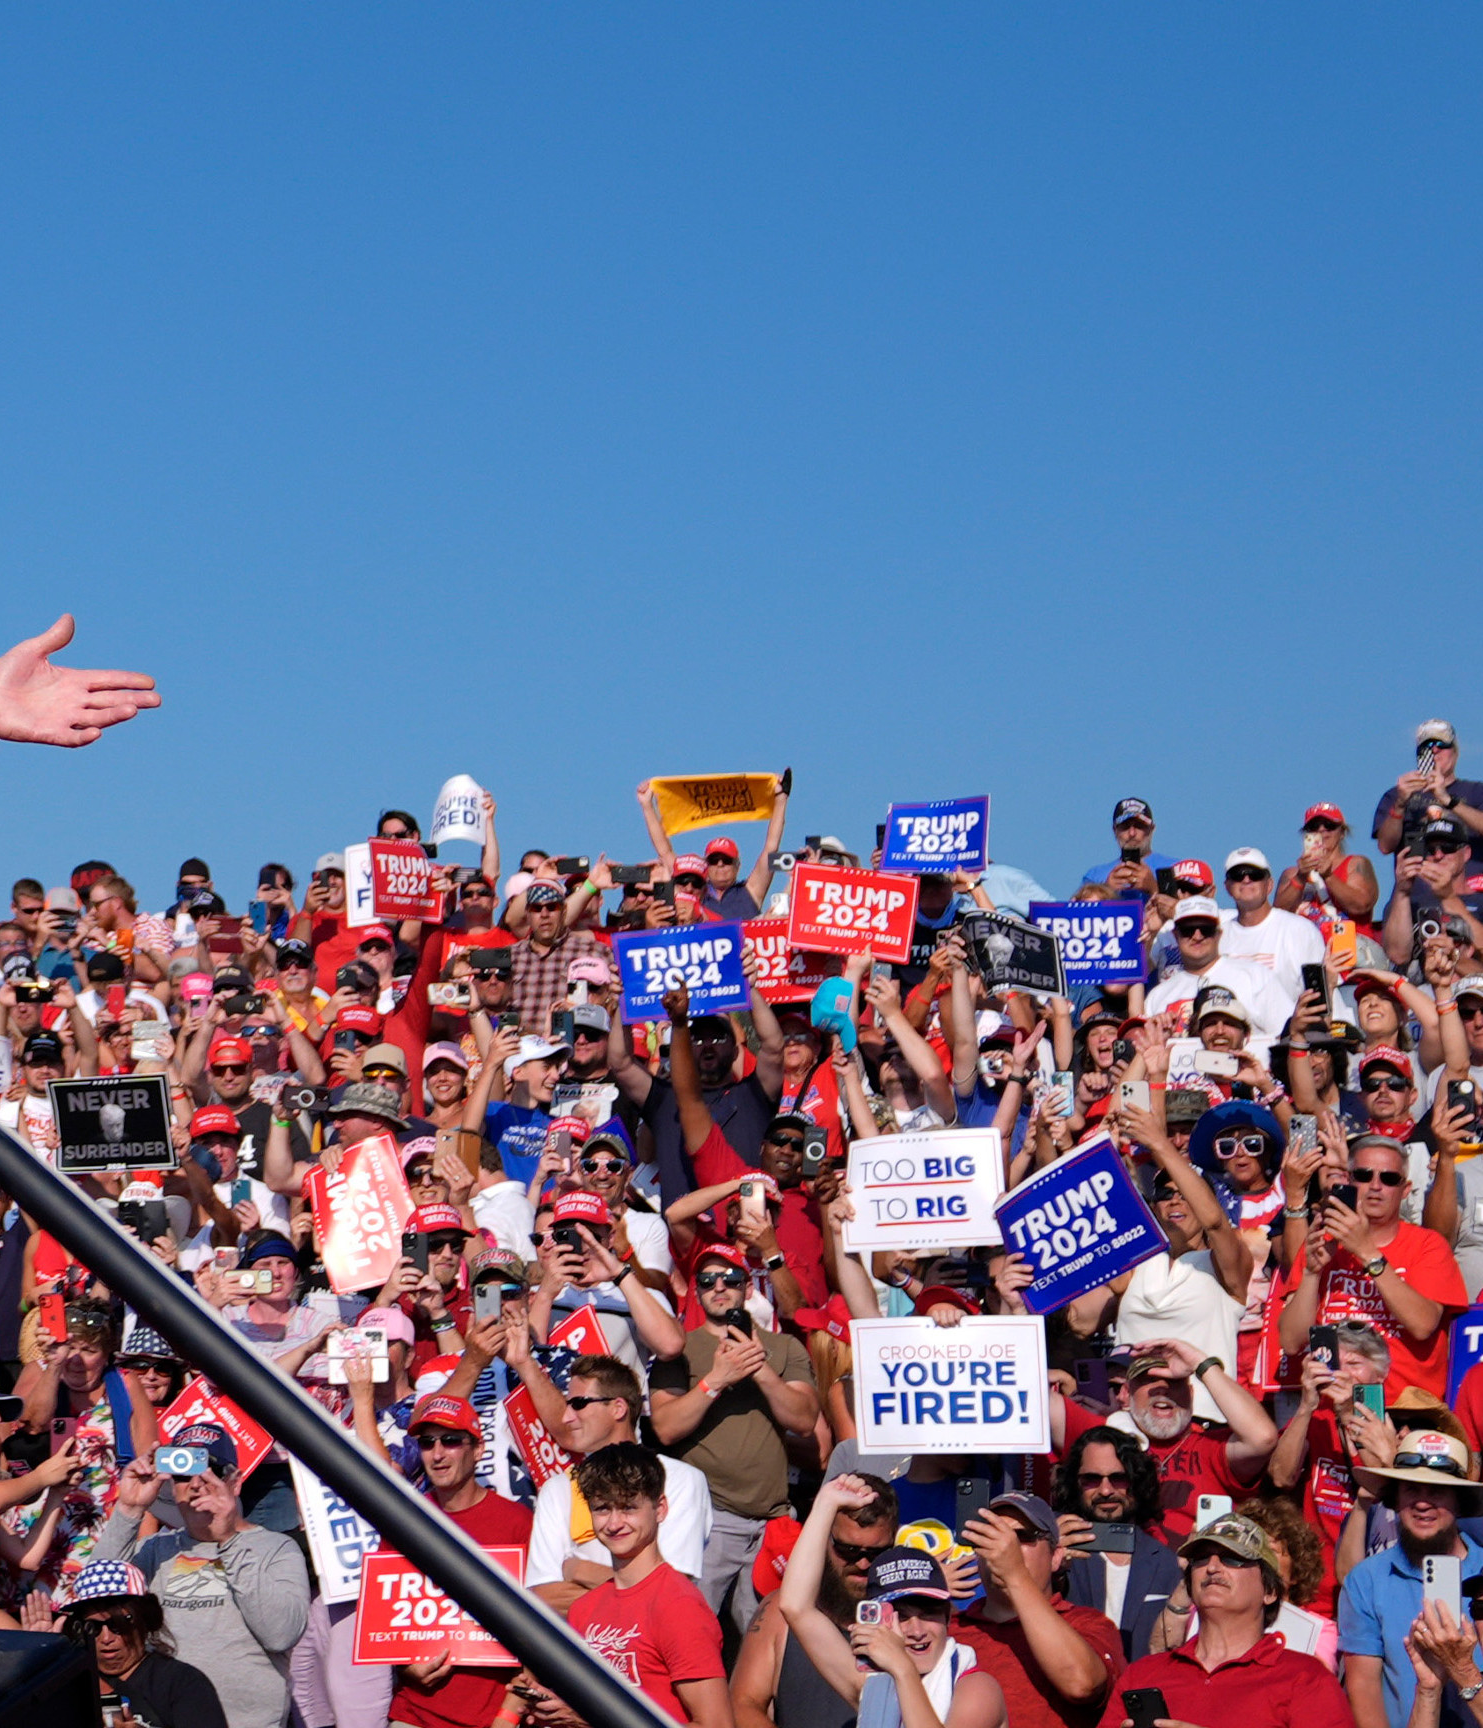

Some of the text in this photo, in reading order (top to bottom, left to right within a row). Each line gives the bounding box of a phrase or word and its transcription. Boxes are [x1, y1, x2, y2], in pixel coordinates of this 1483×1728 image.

[897, 811, 980, 836] TRUMP
[906, 832, 968, 853] 2024
[377, 854, 433, 877] TRUM
[914, 852, 945, 862] TRUMP
[946, 852, 956, 861] TO
[386, 874, 428, 896] 2024
[805, 879, 906, 912] TRUMP
[816, 902, 889, 932] 2024
[1037, 916, 1134, 939] TRUMP
[799, 923, 824, 935] TEXT
[825, 926, 858, 939] TRUMP
[860, 931, 873, 940] TO
[627, 938, 733, 972] TRUMP
[1060, 938, 1122, 960] 2024
[644, 962, 723, 993] 2024
[755, 953, 806, 978] 024
[1095, 961, 1107, 970] TO
[631, 994, 656, 1007] TEXT
[695, 989, 708, 999] TO
[1172, 1054, 1193, 1068] JO
[67, 1088, 150, 1112] NEVER
[63, 1141, 167, 1161] SURRENDER
[861, 1156, 976, 1183] TOO BIG
[353, 1172, 392, 1253] 2024
[870, 1195, 967, 1221] TO RIG
[1010, 1170, 1115, 1250] TRUMP
[1032, 1206, 1118, 1271] 2024
[1031, 1224, 1147, 1293] TEXT TRUMP TO 88022
[1348, 1297, 1384, 1312] 2024
[878, 1344, 1016, 1361] CROOKED JOE
[881, 1361, 1017, 1387] YOU'RE
[473, 1365, 497, 1443] BRANDO
[872, 1391, 1030, 1425] FIRED!
[322, 1486, 364, 1585] RED!
[877, 1559, 934, 1578] MAKE AMERICA
[880, 1570, 931, 1586] GREAT AGAIN
[377, 1573, 447, 1601] TRU
[161, 1596, 224, 1611] patagonia
[369, 1632, 402, 1642] TEXT
[402, 1630, 445, 1642] TRUMP
[448, 1630, 466, 1641] TO
